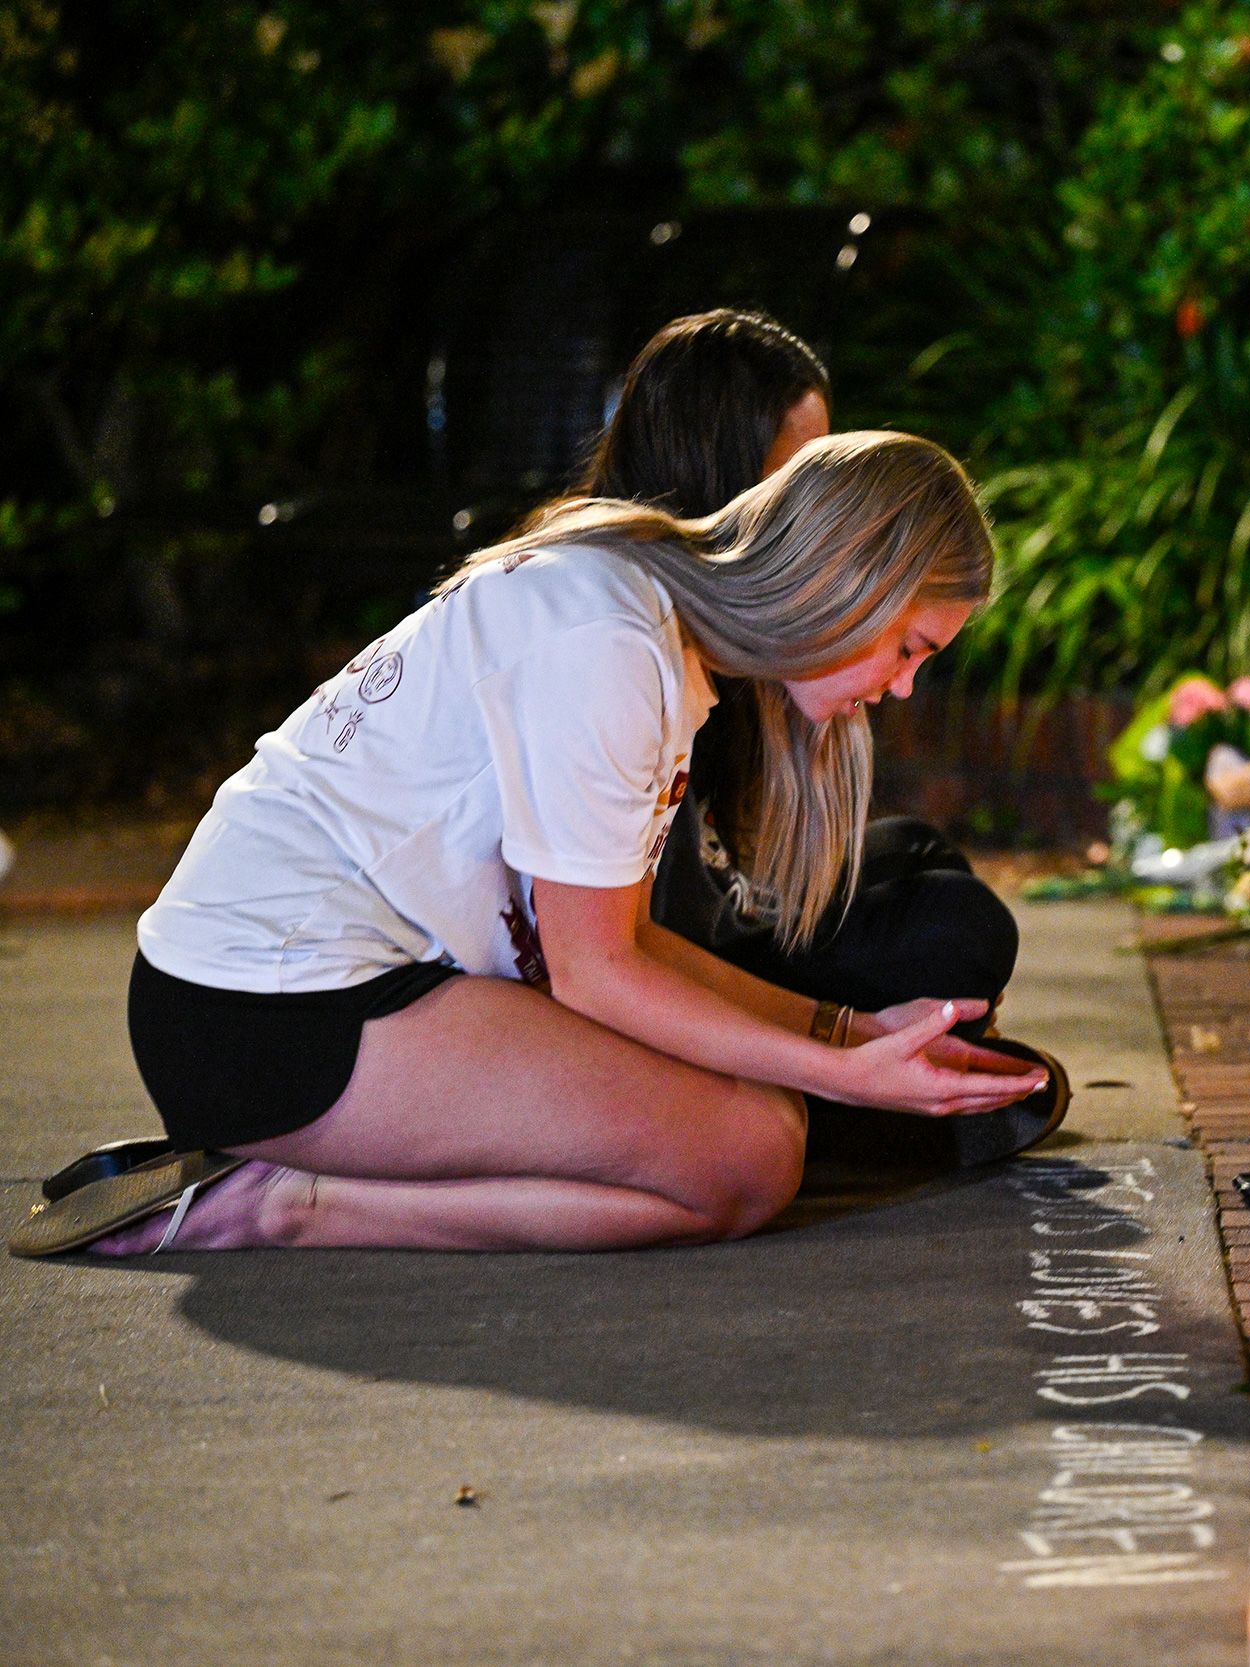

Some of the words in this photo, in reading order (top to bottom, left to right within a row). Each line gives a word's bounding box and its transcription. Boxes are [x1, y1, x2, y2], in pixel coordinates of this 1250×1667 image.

[1007, 1159, 1155, 1236] JESUS
[1017, 1249, 1161, 1337] LOVES
[1034, 1353, 1191, 1405] HIS
[998, 1424, 1229, 1588] CHILDREN
